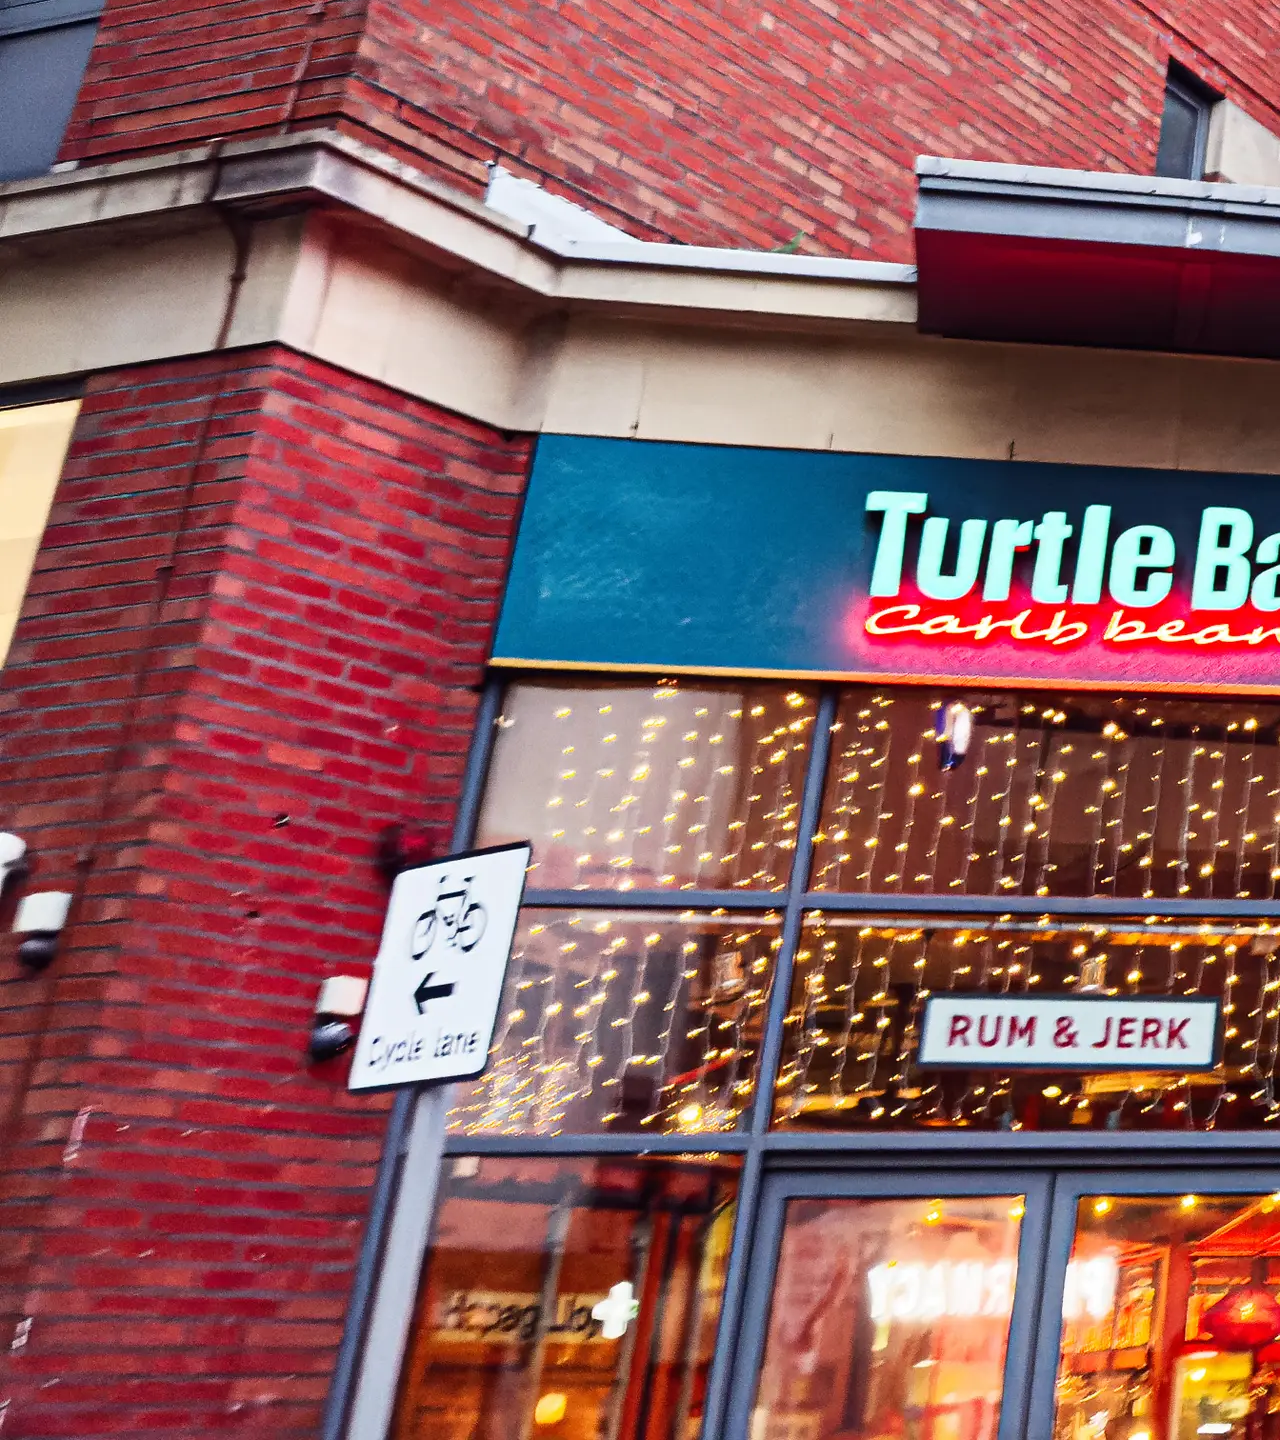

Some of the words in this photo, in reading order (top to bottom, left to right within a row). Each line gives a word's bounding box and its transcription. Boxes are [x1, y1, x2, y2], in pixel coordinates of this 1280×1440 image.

[865, 491, 1175, 607] Turtle
[368, 1029, 423, 1073] Cycle
[434, 1027, 481, 1058] lane
[947, 1015, 1039, 1048] RUM
[1053, 1015, 1079, 1049] &
[1091, 1016, 1192, 1049] JERK
